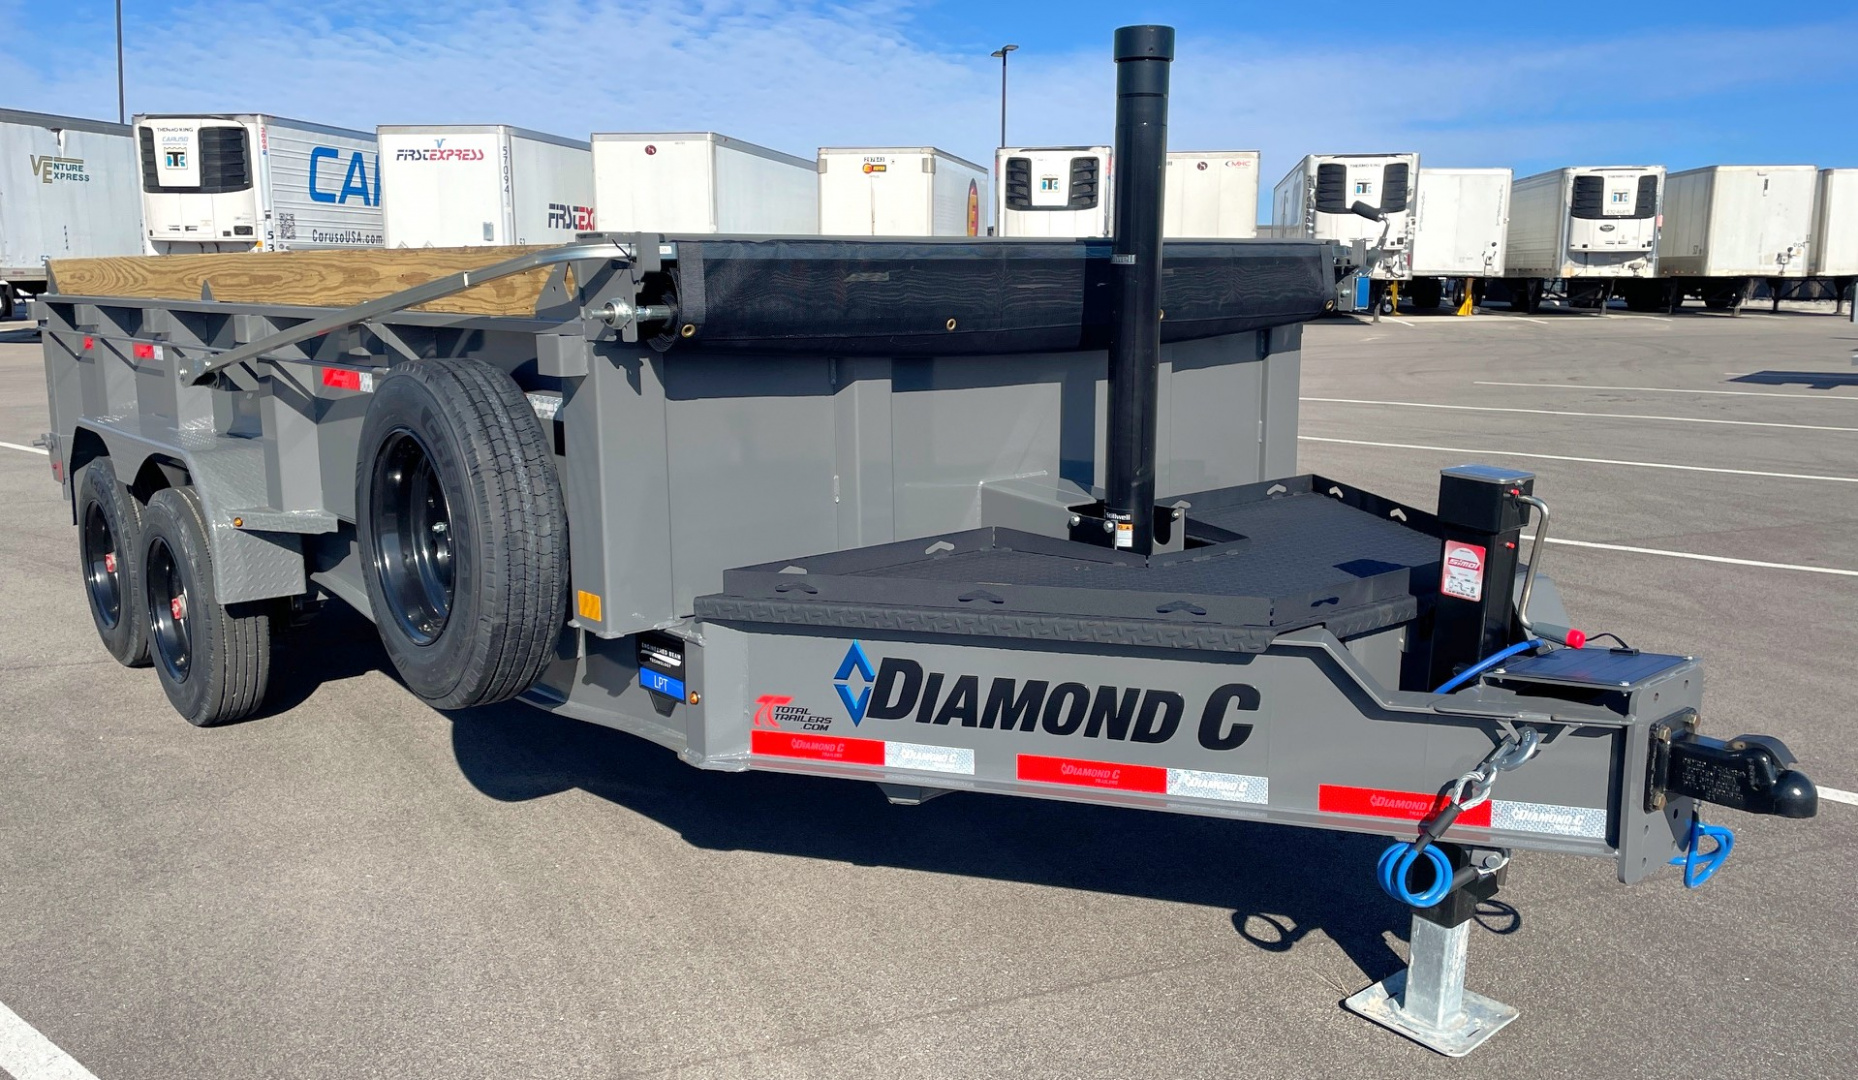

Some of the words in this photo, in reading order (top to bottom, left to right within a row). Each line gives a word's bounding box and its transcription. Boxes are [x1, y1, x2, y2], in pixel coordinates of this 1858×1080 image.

[312, 229, 383, 244] CarusoUSA.com
[654, 675, 668, 691] LPT
[775, 705, 812, 715] TOTAL
[866, 656, 1186, 744] DIAMOND
[1197, 682, 1261, 751] C
[774, 713, 833, 724] TRAILERS
[800, 722, 829, 731] .COM
[797, 739, 836, 752] DIAMOND
[836, 742, 845, 753] C
[1066, 764, 1112, 779] DIAMOND
[1111, 769, 1121, 780] C
[1192, 777, 1239, 791] DIAMOND
[1239, 780, 1249, 792] C
[1376, 797, 1427, 811] DIAMOND
[1519, 809, 1573, 823] DIAMOND
